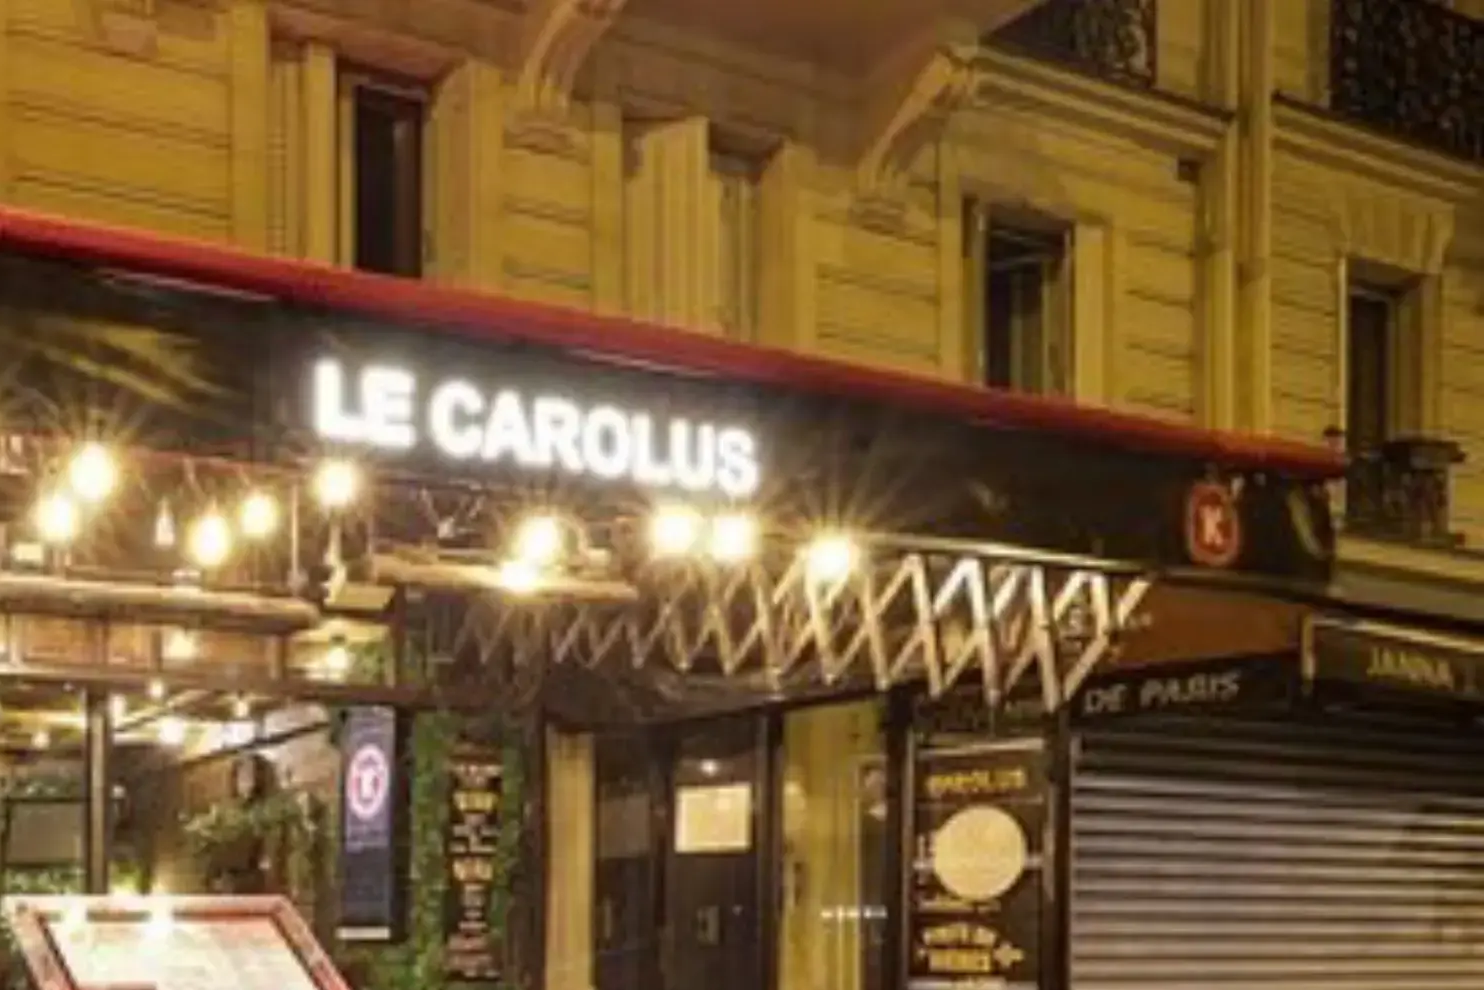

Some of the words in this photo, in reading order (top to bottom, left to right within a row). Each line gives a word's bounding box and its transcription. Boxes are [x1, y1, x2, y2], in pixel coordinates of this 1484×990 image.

[313, 358, 414, 449] LE
[430, 380, 759, 495] CAROLUS
[1084, 683, 1128, 714] DE
[1139, 671, 1241, 707] PARIS
